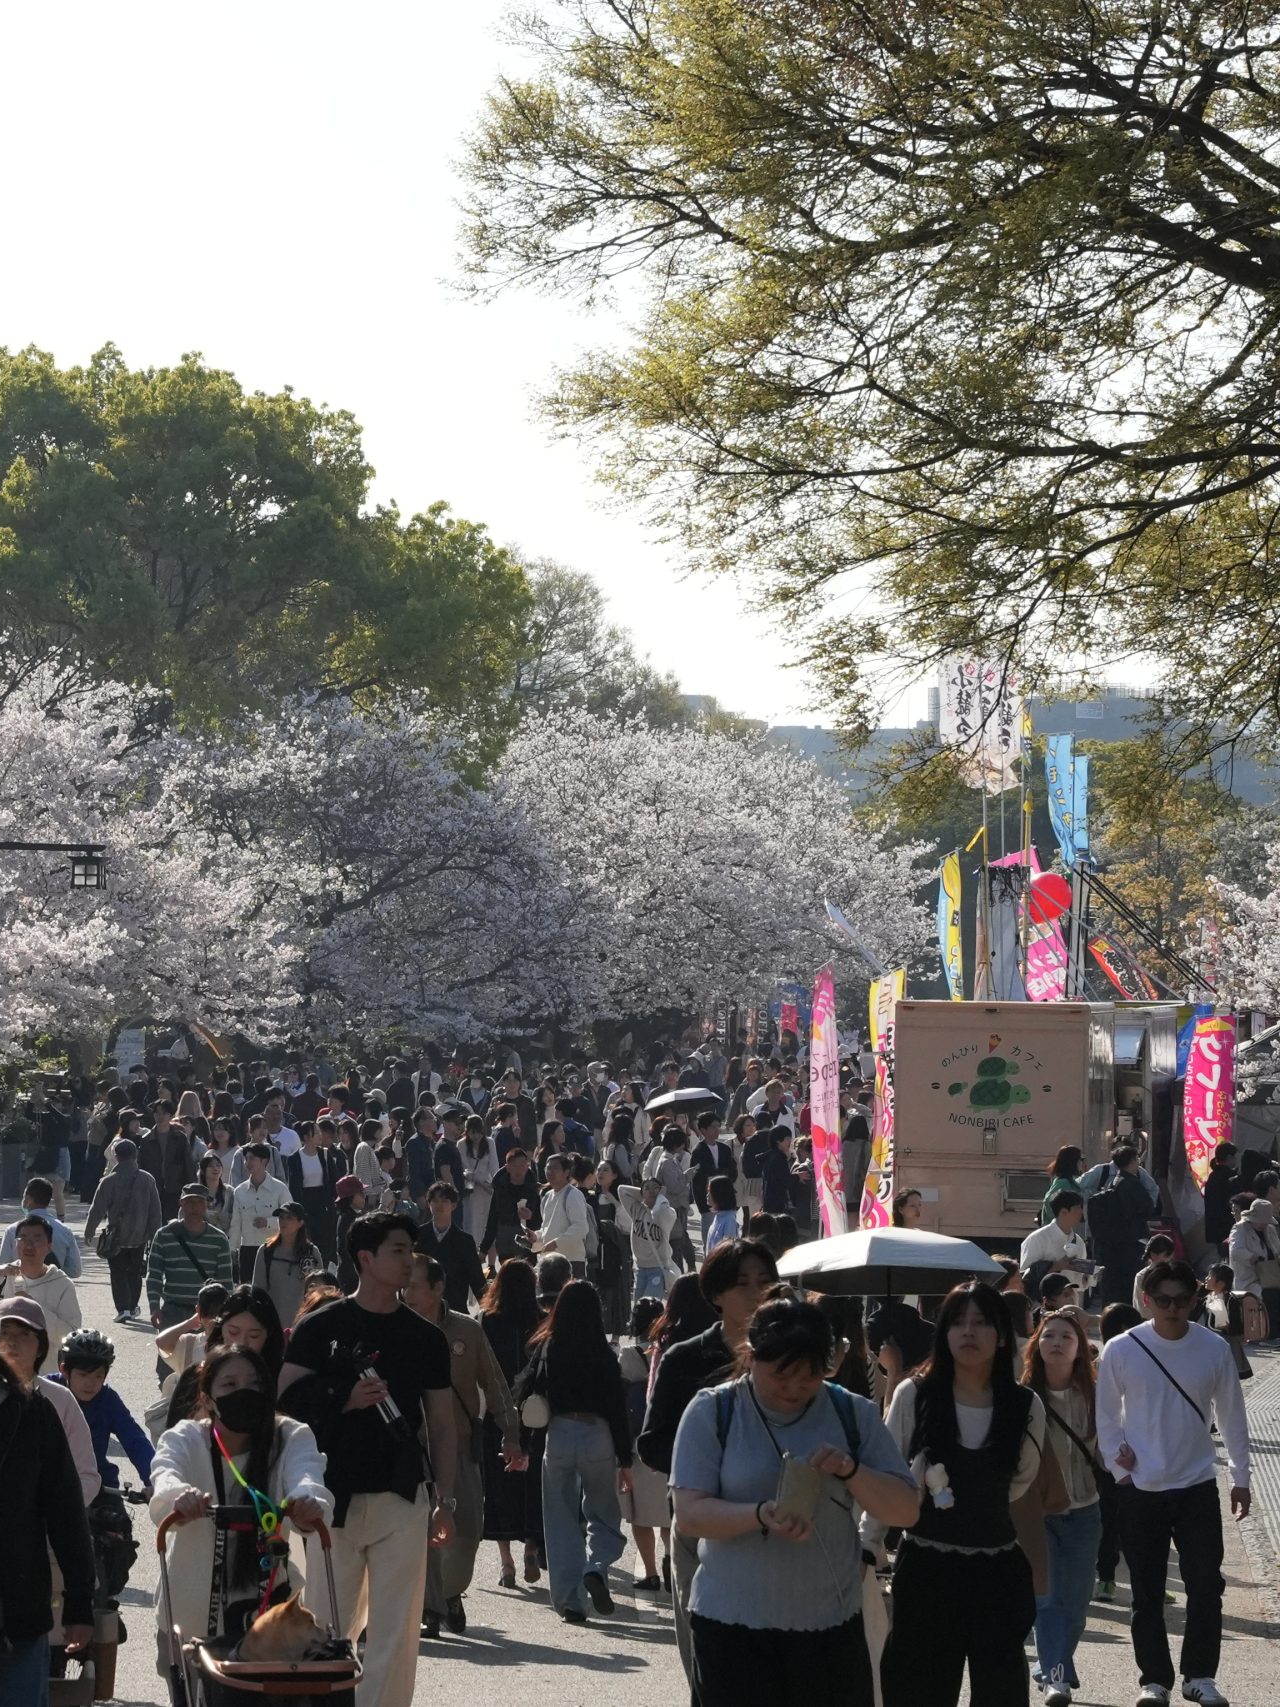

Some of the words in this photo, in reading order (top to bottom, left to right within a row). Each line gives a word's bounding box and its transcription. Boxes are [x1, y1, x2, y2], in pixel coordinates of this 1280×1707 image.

[1010, 1045, 1044, 1071] カフェ
[948, 1112, 1000, 1128] NONBIRI
[1003, 1114, 1035, 1128] CAFE
